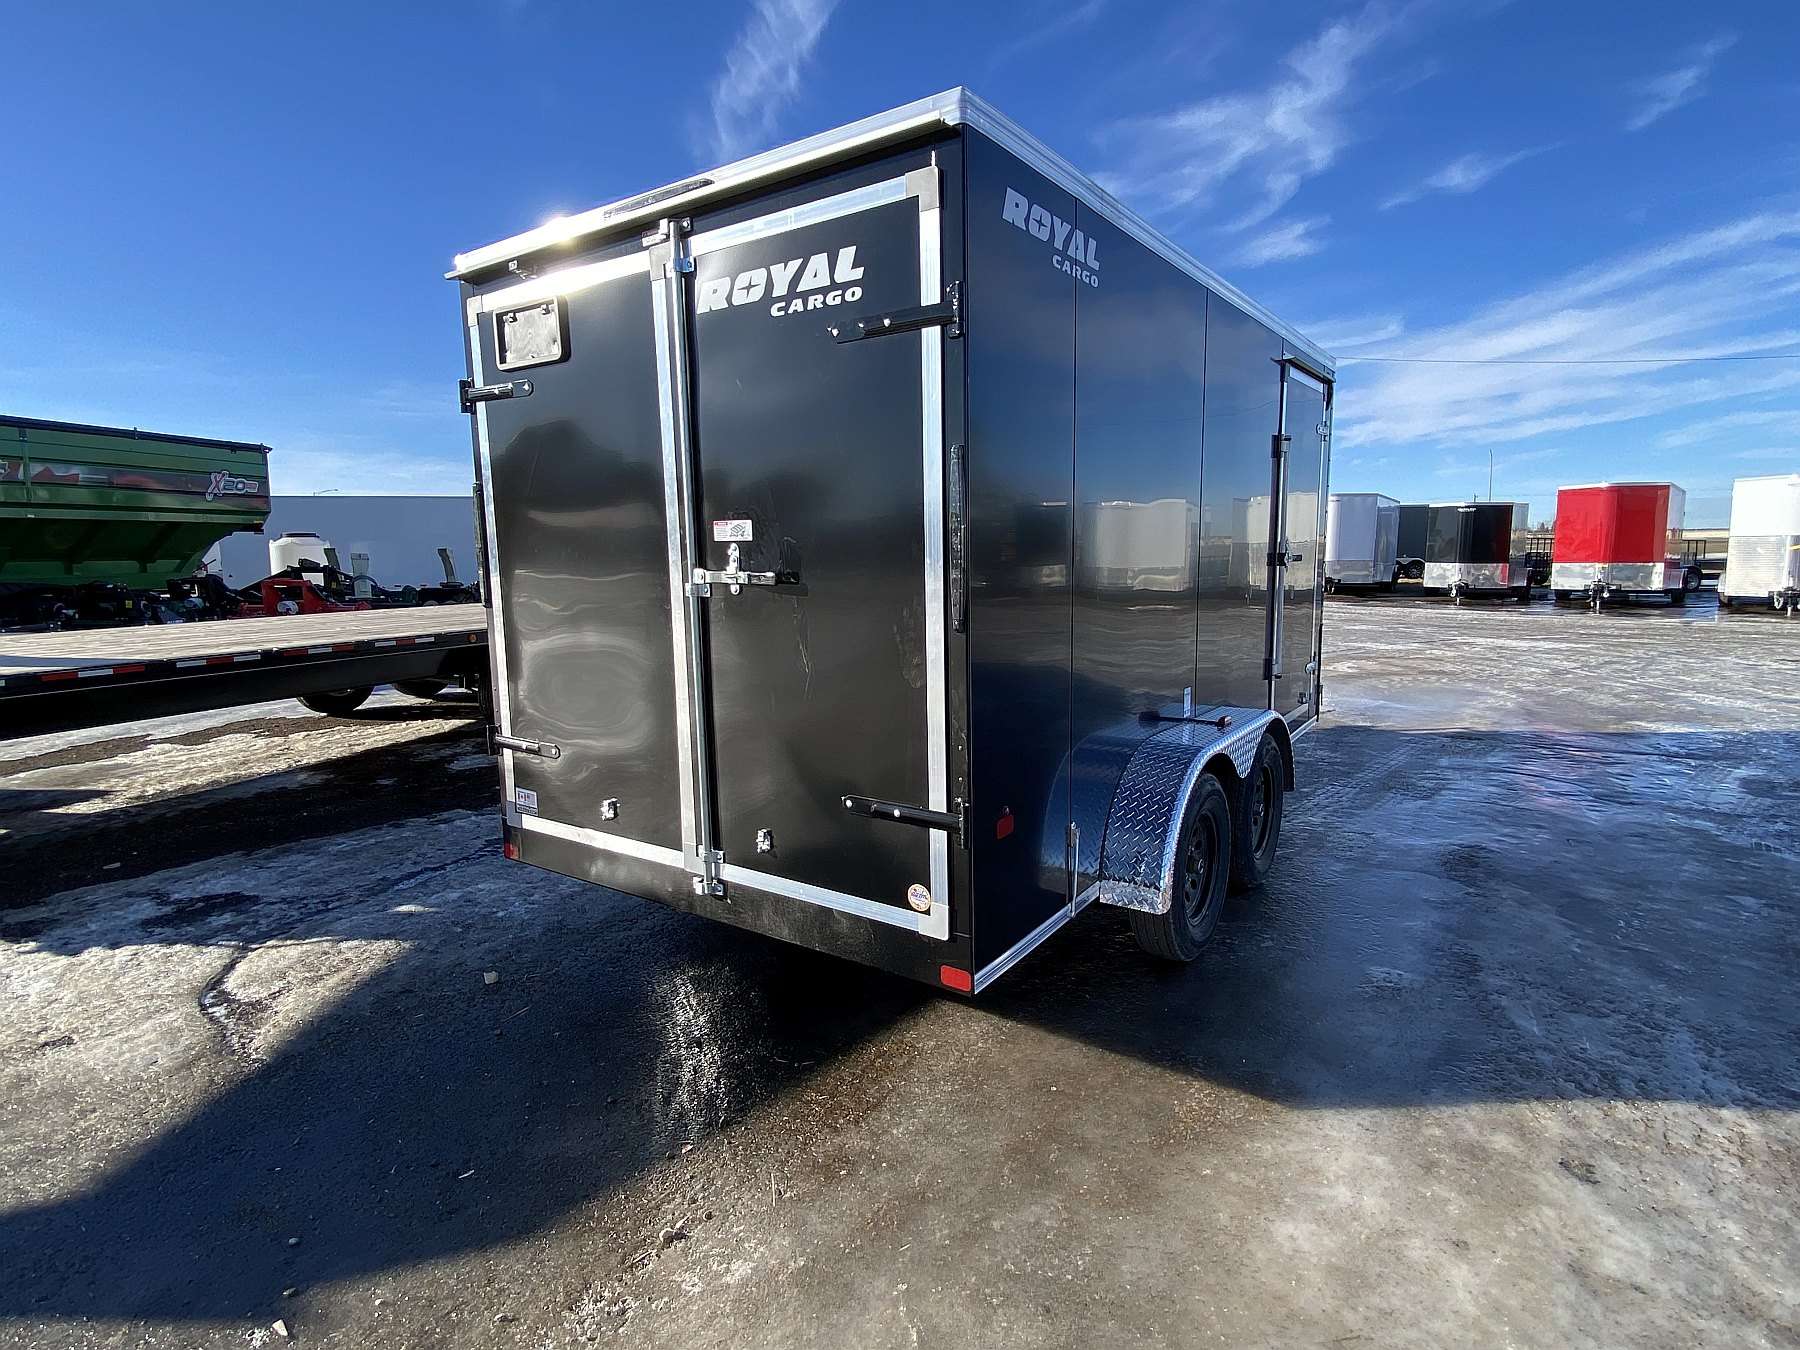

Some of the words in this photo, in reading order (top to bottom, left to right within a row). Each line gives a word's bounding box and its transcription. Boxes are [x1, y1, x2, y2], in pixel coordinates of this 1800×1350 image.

[1002, 186, 1100, 271] ROYAL
[696, 245, 865, 315] ROYAL
[1053, 254, 1099, 288] CARGO
[770, 286, 863, 317] CARGO
